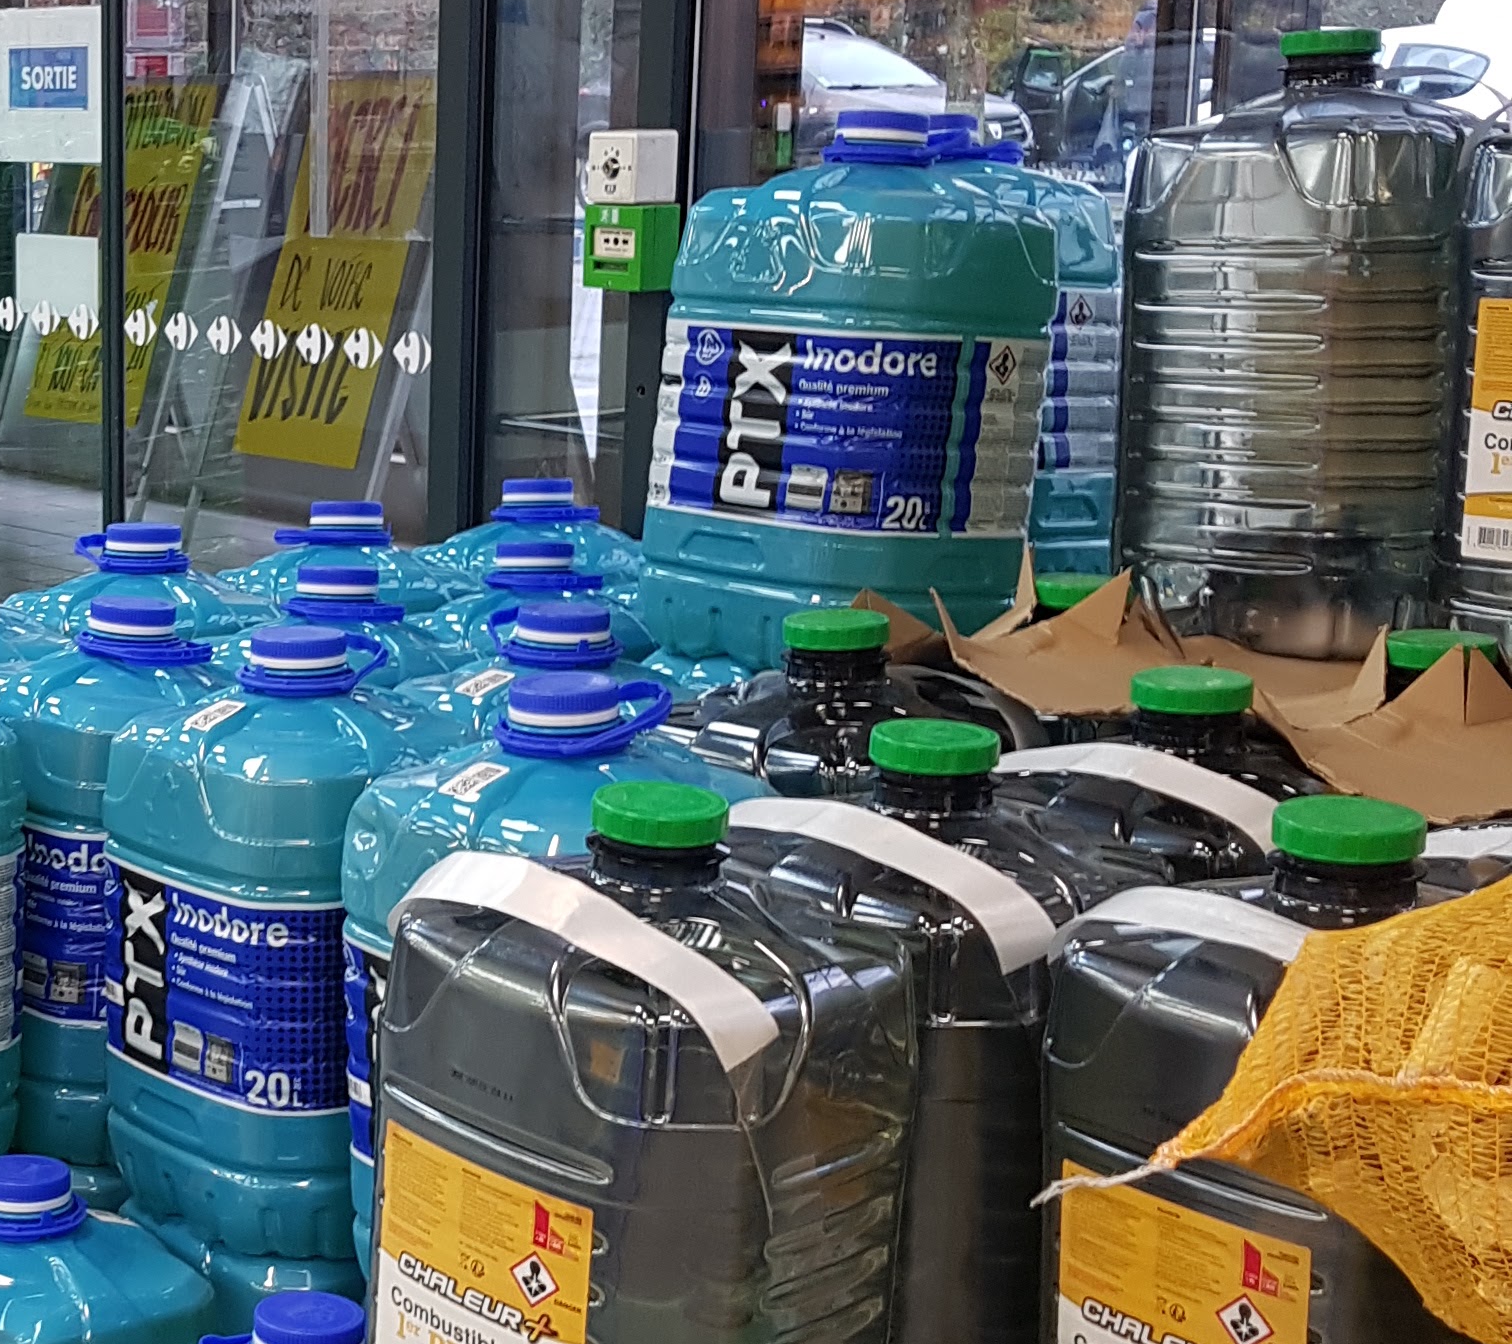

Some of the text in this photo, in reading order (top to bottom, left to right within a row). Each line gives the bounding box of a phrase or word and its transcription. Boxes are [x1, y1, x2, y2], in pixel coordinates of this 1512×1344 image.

[21, 66, 77, 90] SORTIE
[803, 339, 938, 377] Inodore
[836, 383, 890, 398] premium
[719, 340, 792, 508] PTX
[27, 833, 107, 873] Inodo
[50, 880, 97, 895] premium
[171, 892, 289, 948] Inodore
[125, 879, 166, 1060] PTX
[398, 1251, 524, 1333] CHALEUR
[395, 1311, 420, 1341] 1er
